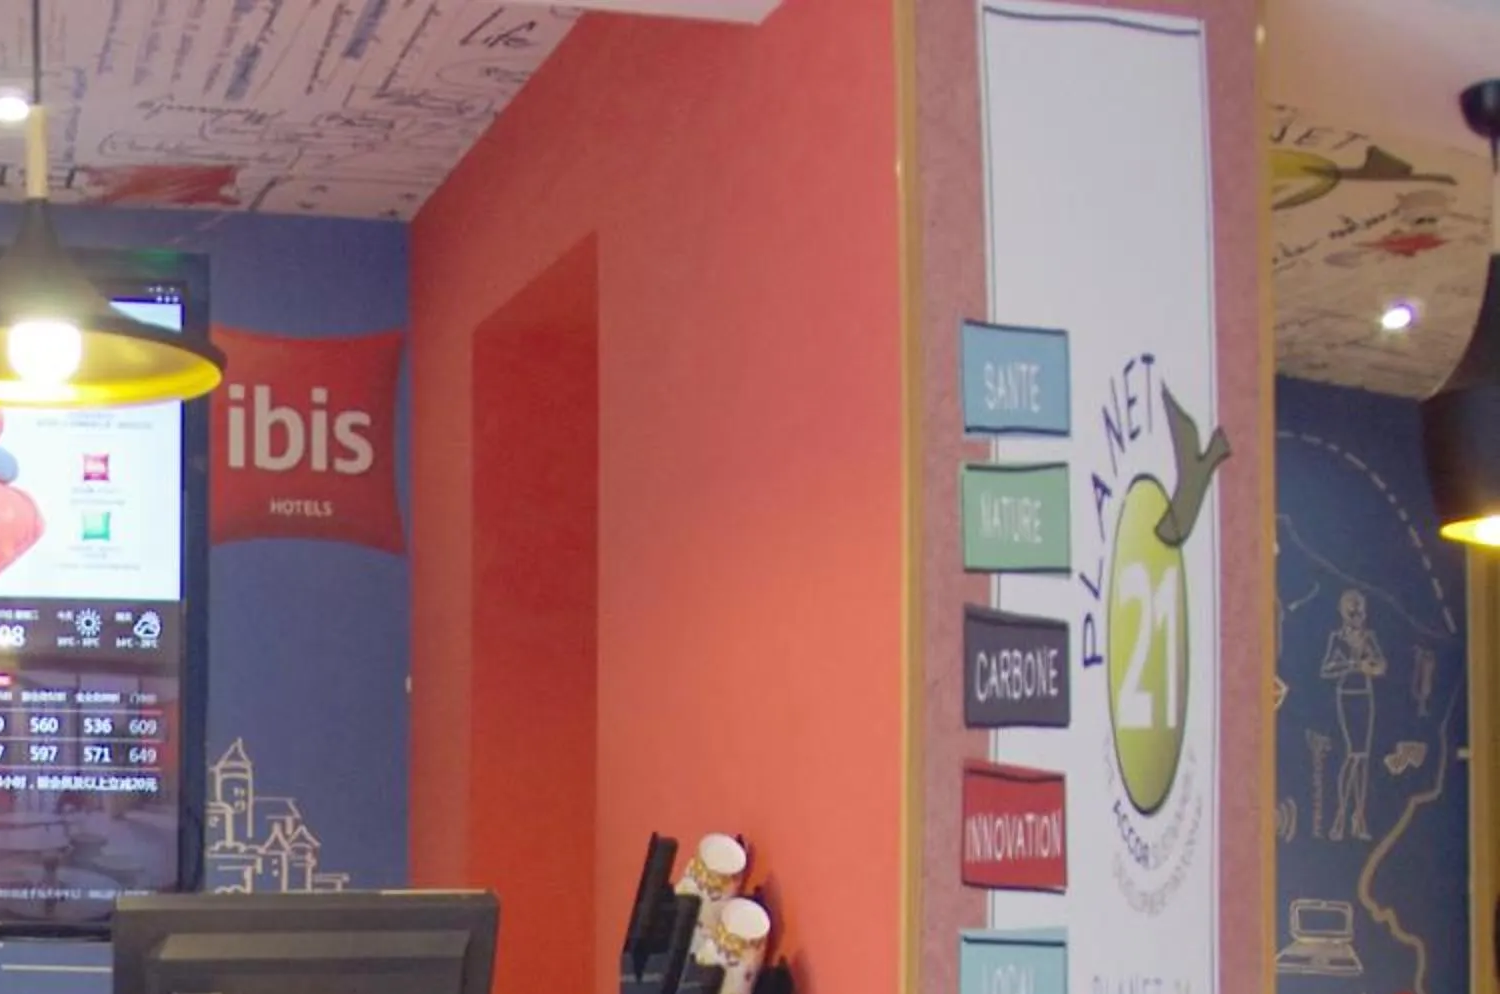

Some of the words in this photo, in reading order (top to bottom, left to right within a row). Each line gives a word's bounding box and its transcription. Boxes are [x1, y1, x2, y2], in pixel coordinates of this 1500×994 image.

[228, 383, 373, 475] ibis
[269, 498, 334, 517] HOTELS
[980, 492, 1042, 545] NATURE
[1078, 354, 1156, 667] PLANET
[1116, 562, 1179, 730] 21
[974, 648, 1060, 702] CARBONE
[30, 716, 59, 734] 560
[83, 717, 112, 735] 536
[129, 719, 157, 736] 609
[30, 745, 58, 763] 597
[83, 746, 112, 764] 571
[129, 747, 157, 765] 649
[965, 812, 1061, 865] INNOVATION
